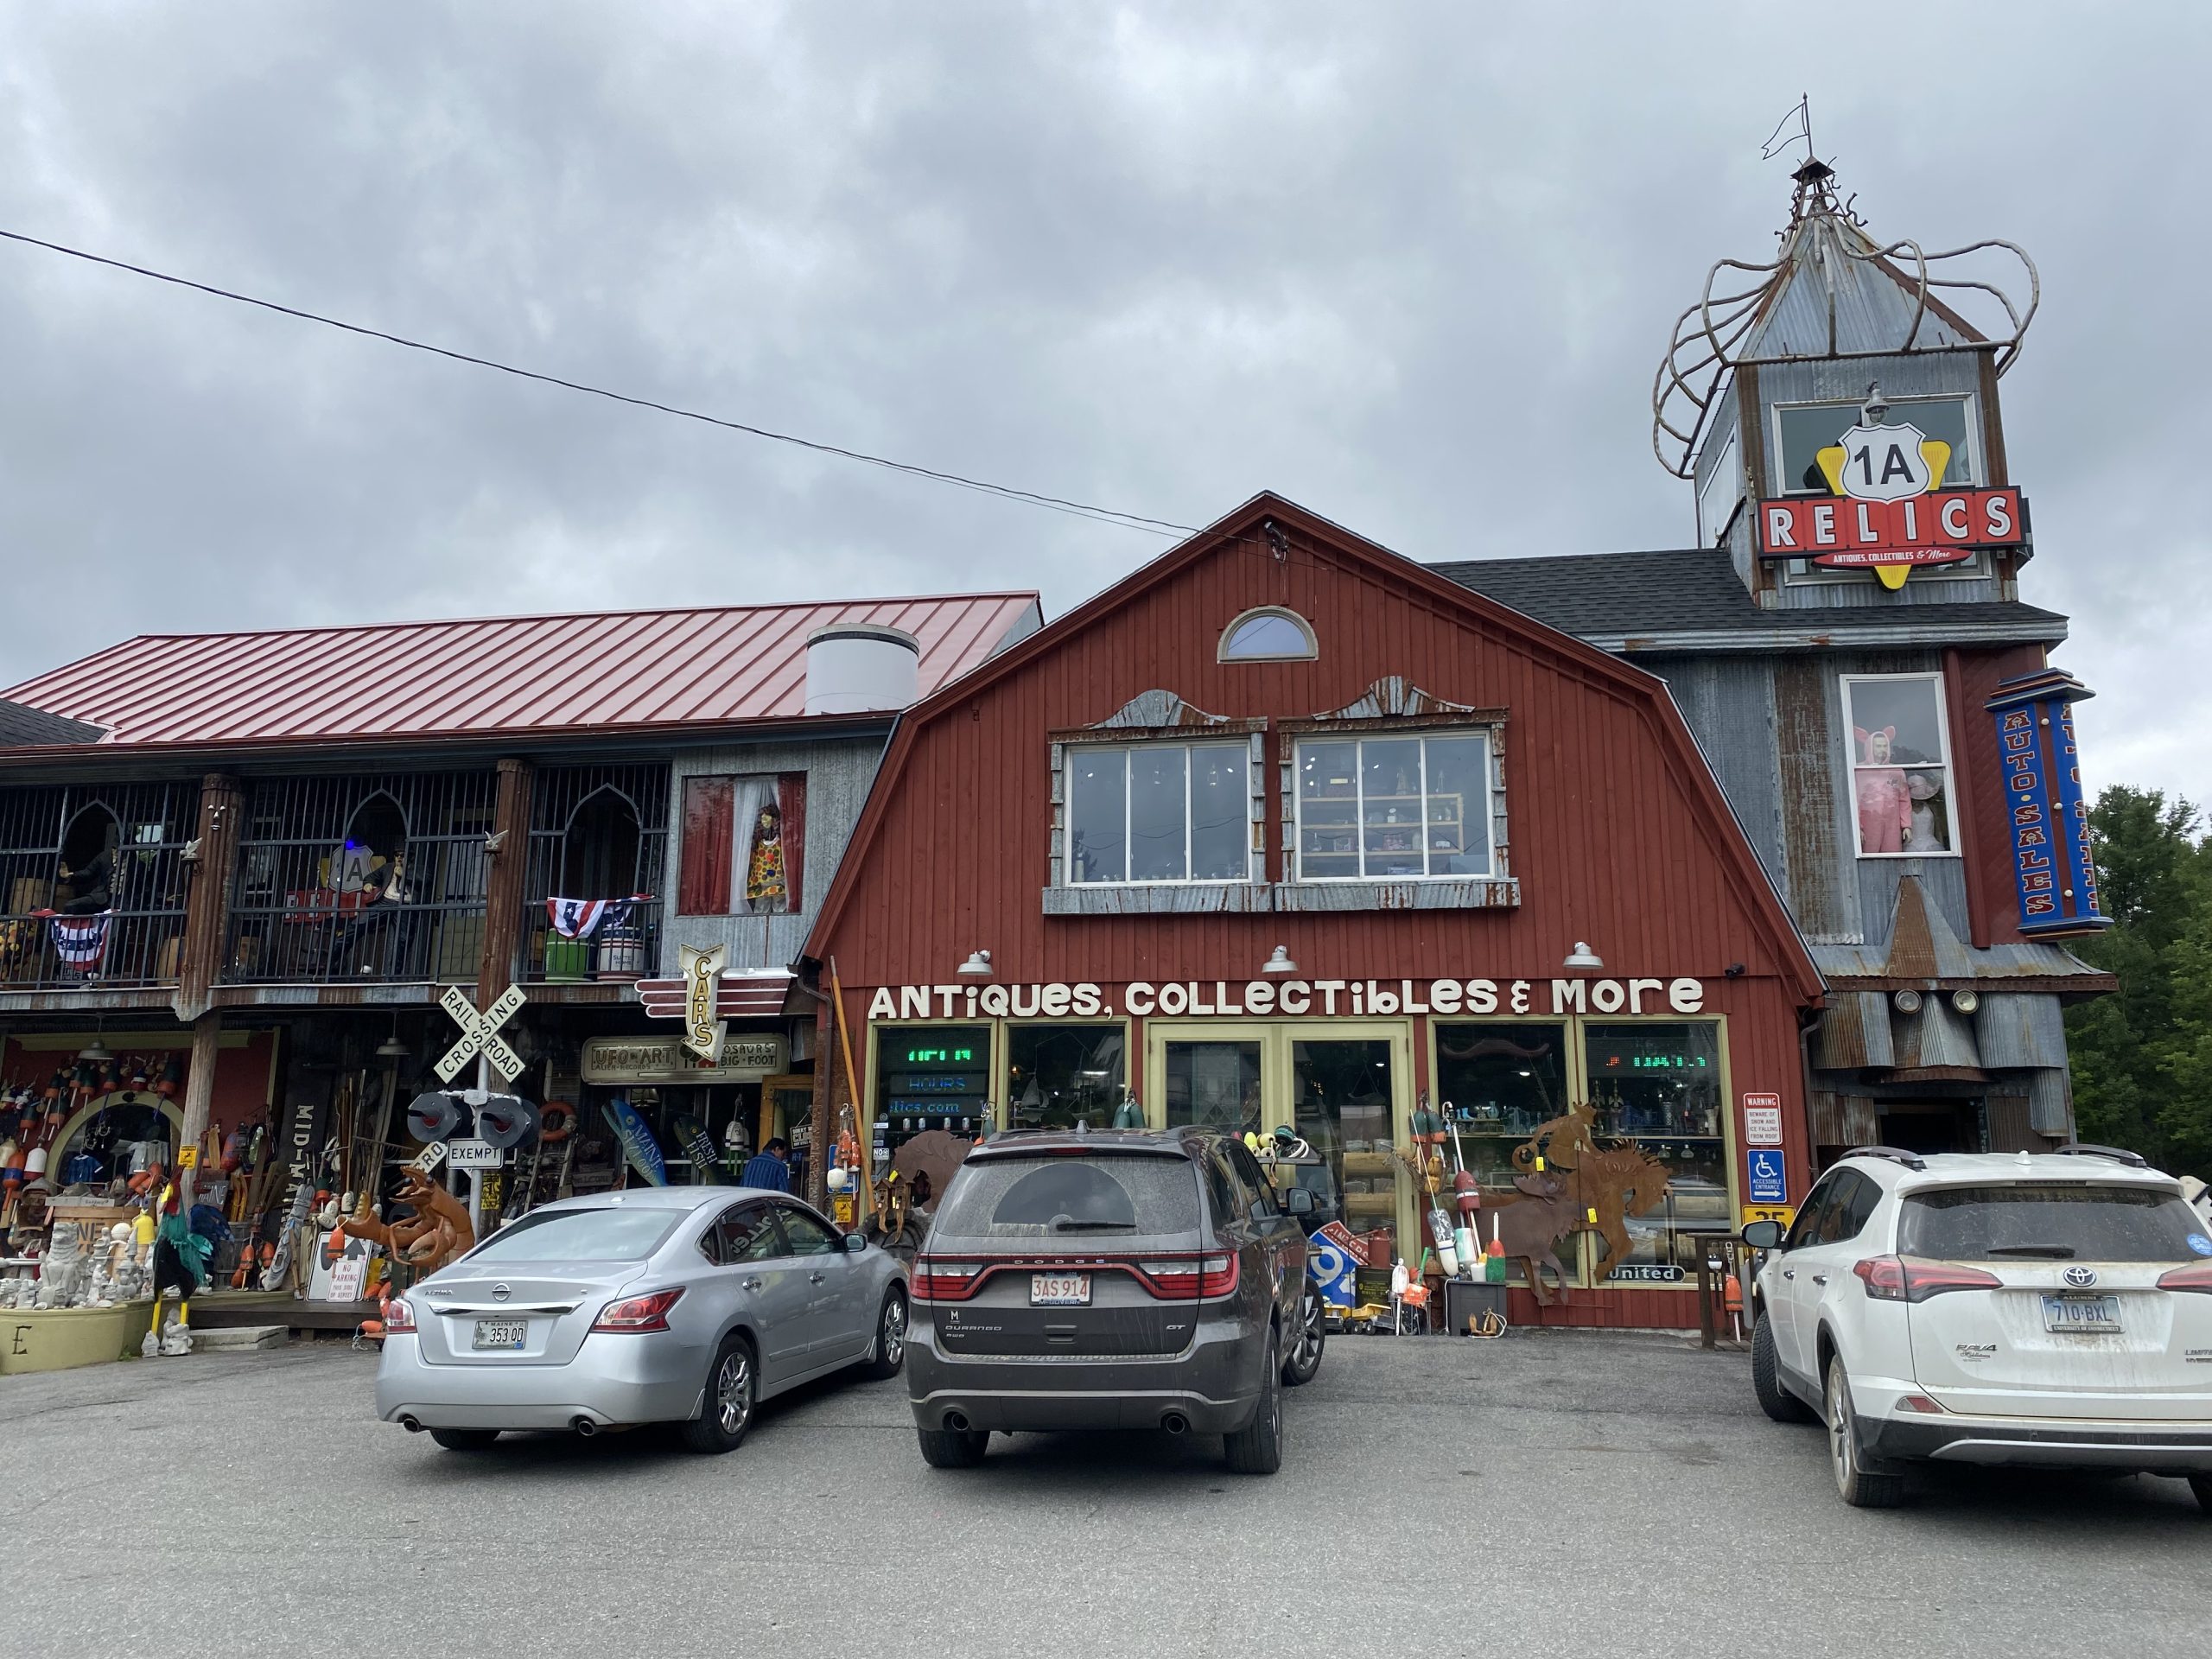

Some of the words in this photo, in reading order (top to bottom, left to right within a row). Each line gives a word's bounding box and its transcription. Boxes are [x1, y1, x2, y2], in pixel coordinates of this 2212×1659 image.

[1854, 444, 1915, 486] 1A
[1768, 495, 2012, 547] RELICS
[1834, 554, 1867, 563] ANTIQUES,
[1868, 551, 1914, 561] COLLECTIBLES
[1926, 549, 1951, 560] More
[2004, 710, 2037, 791] AUTO
[2014, 804, 2055, 916] SALES
[444, 991, 474, 1028] RAIL
[690, 956, 712, 1046] CARS
[1510, 980, 1530, 1014] &
[442, 993, 518, 1074] CROSSING
[722, 1044, 772, 1054] OSAURS
[484, 1038, 518, 1076] ROAD
[595, 1049, 628, 1065] UFO
[640, 1046, 675, 1064] ART
[721, 1056, 740, 1065] BIG
[747, 1055, 776, 1065] FOOT
[909, 1077, 965, 1090] HOURS
[1747, 1097, 1777, 1106] WARNING
[451, 1147, 499, 1160] EXEMPT
[633, 1124, 664, 1168] MAINE
[686, 1141, 709, 1169] FISH
[696, 1130, 718, 1165] FRESH
[1033, 1280, 1058, 1298] 3AS
[1062, 1280, 1088, 1298] 914
[489, 1328, 509, 1342] 353
